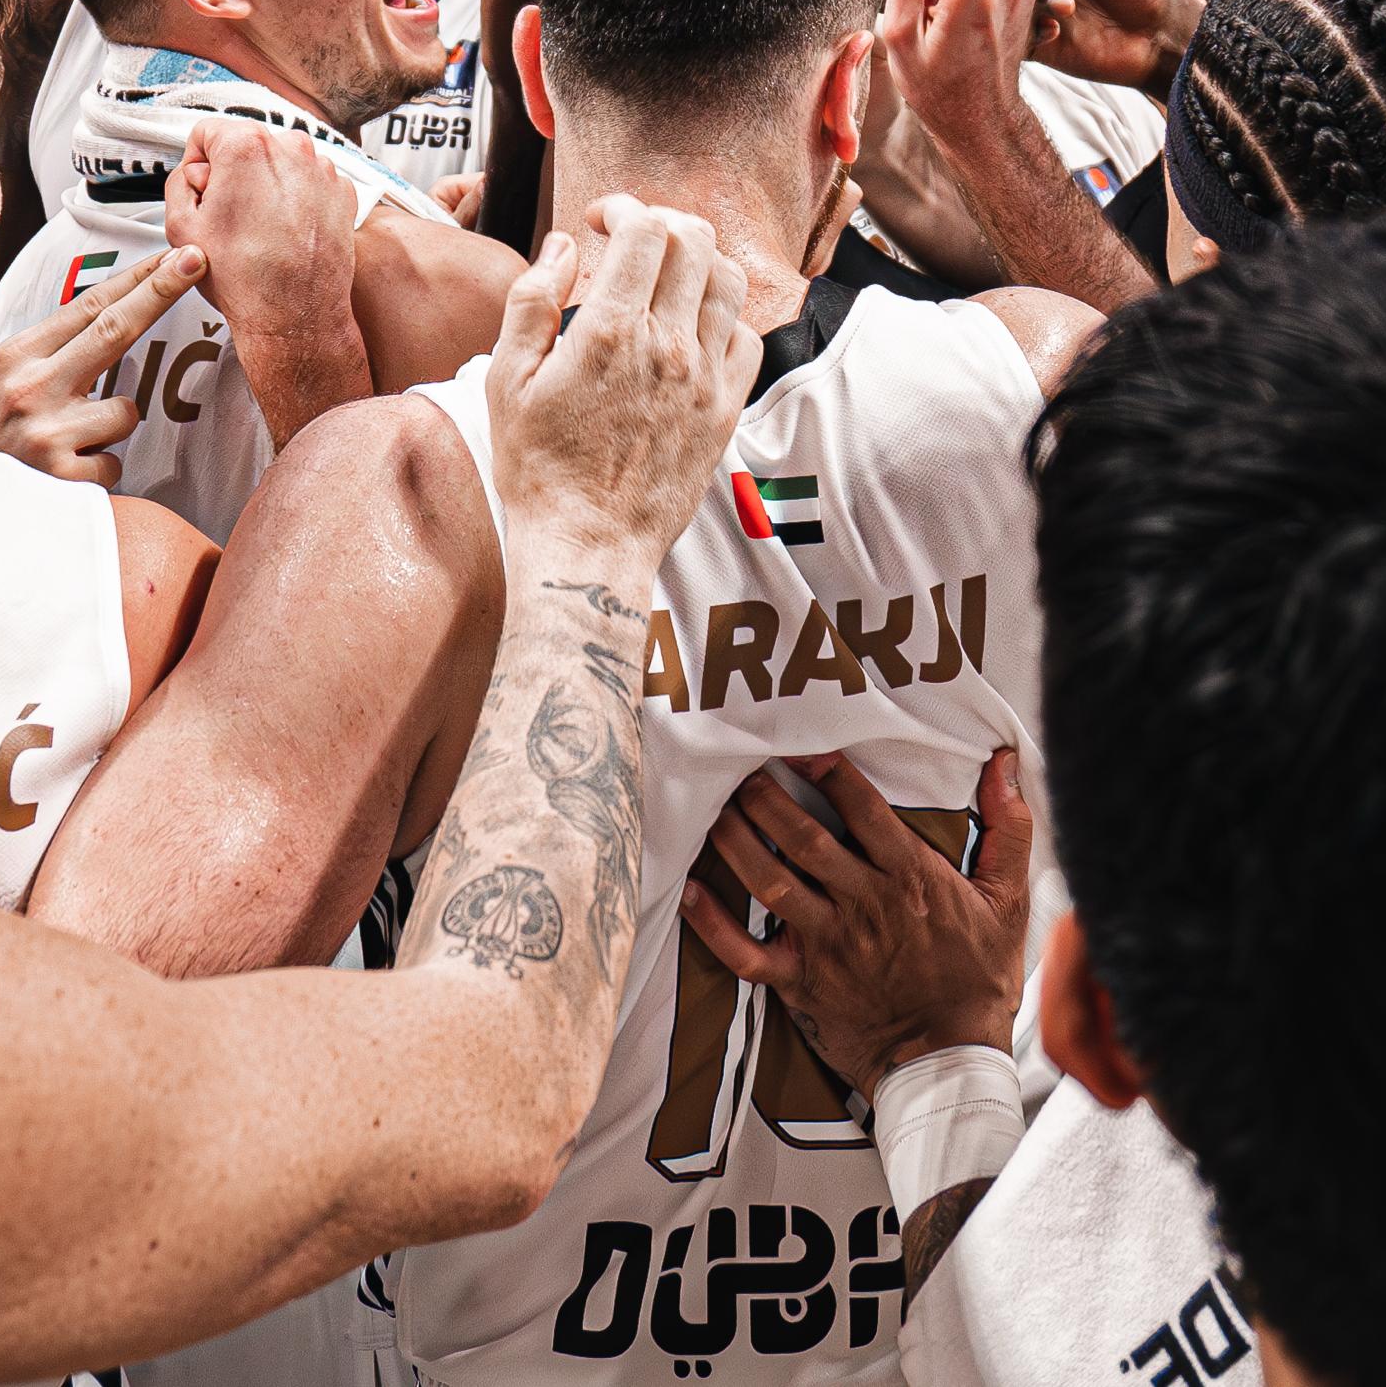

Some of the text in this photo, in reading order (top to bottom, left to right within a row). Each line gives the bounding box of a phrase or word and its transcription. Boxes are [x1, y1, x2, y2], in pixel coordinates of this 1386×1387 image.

[385, 113, 472, 151] DUBA
[643, 573, 987, 714] ARAKJI
[552, 1204, 905, 1380] DUBA
